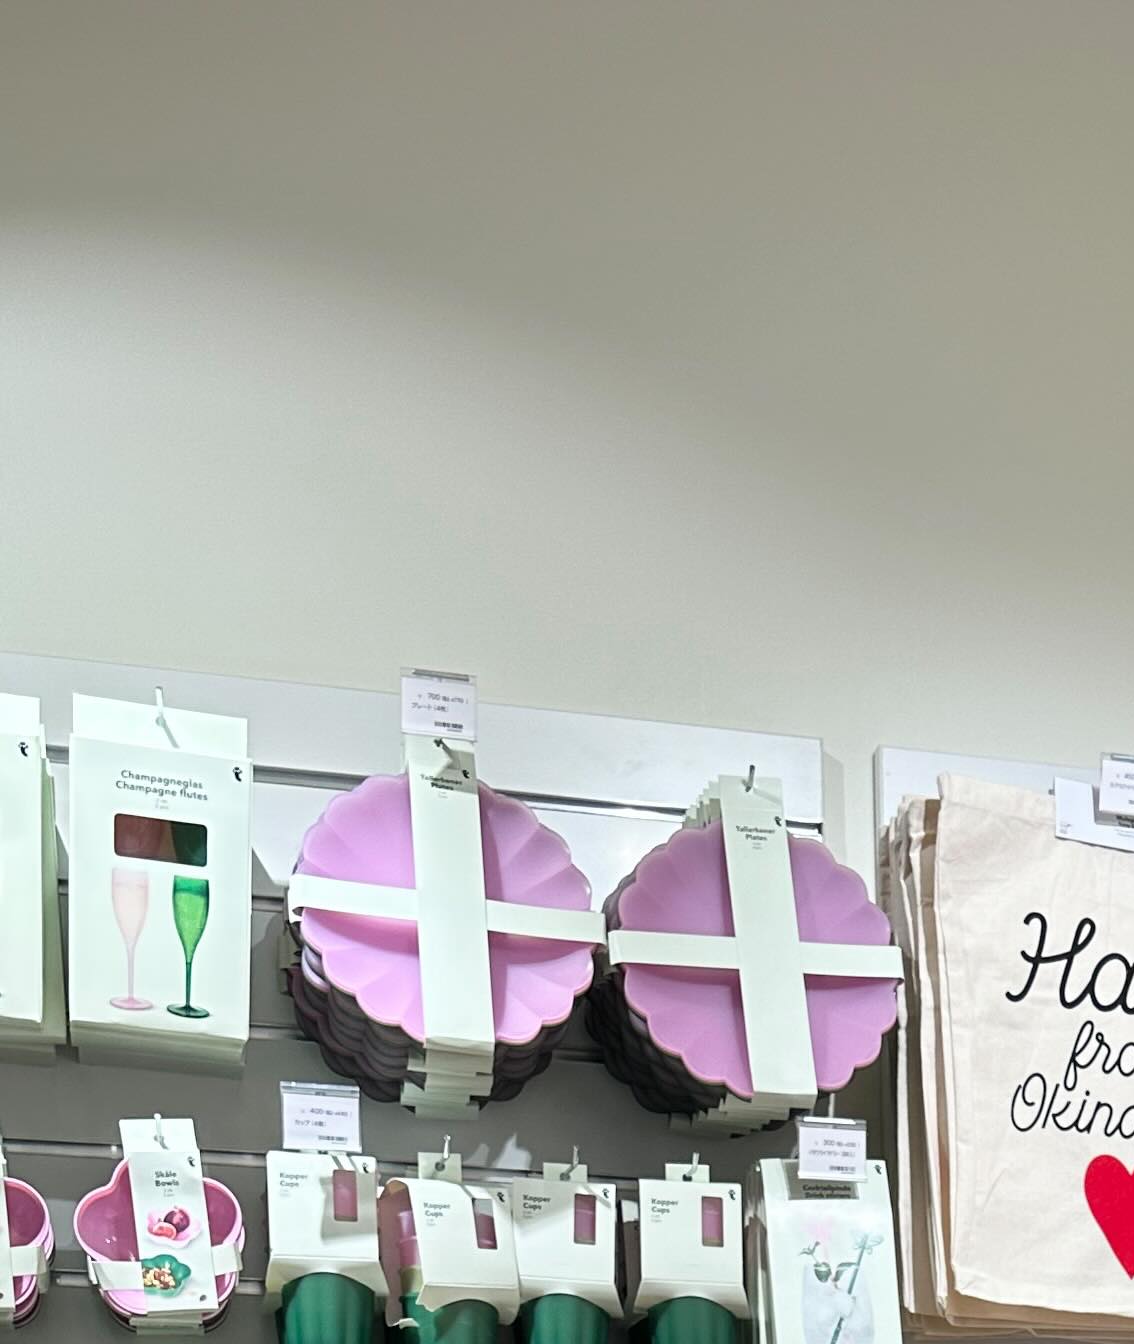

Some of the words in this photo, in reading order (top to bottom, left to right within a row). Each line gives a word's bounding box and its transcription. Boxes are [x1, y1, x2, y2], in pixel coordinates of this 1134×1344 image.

[121, 769, 203, 789] Champagneglas
[116, 780, 177, 797] Champagne
[180, 788, 208, 801] flutes
[523, 1202, 542, 1211] Cups
[651, 1206, 670, 1215] Cups
[425, 1210, 443, 1218] Cups
